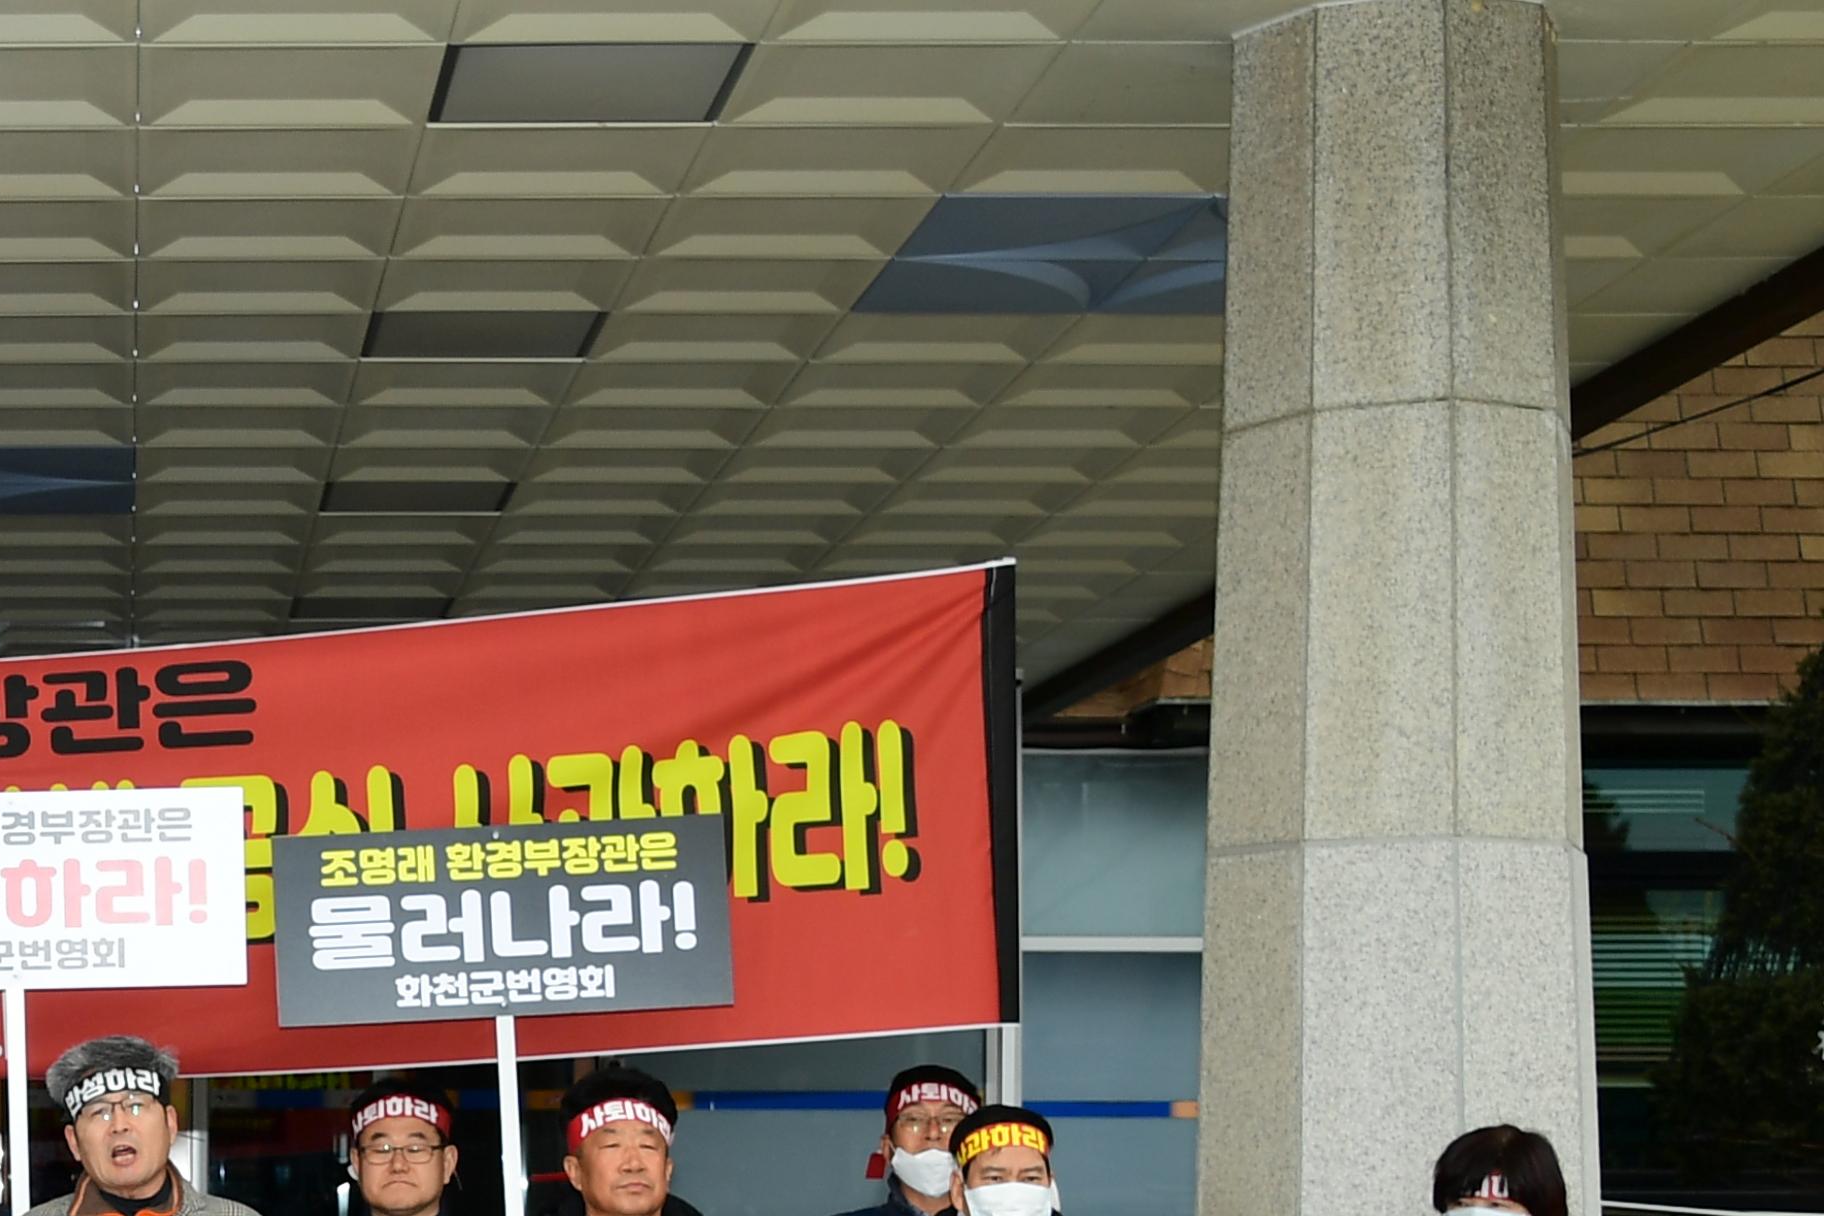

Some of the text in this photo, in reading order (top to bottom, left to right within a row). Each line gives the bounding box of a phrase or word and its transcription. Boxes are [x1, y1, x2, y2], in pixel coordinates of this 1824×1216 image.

[323, 832, 678, 887] 조명래 환경부장관은
[308, 879, 698, 971] 물러나라!
[394, 963, 616, 1008] 화천군번영회
[64, 1067, 161, 1119] 반성하라
